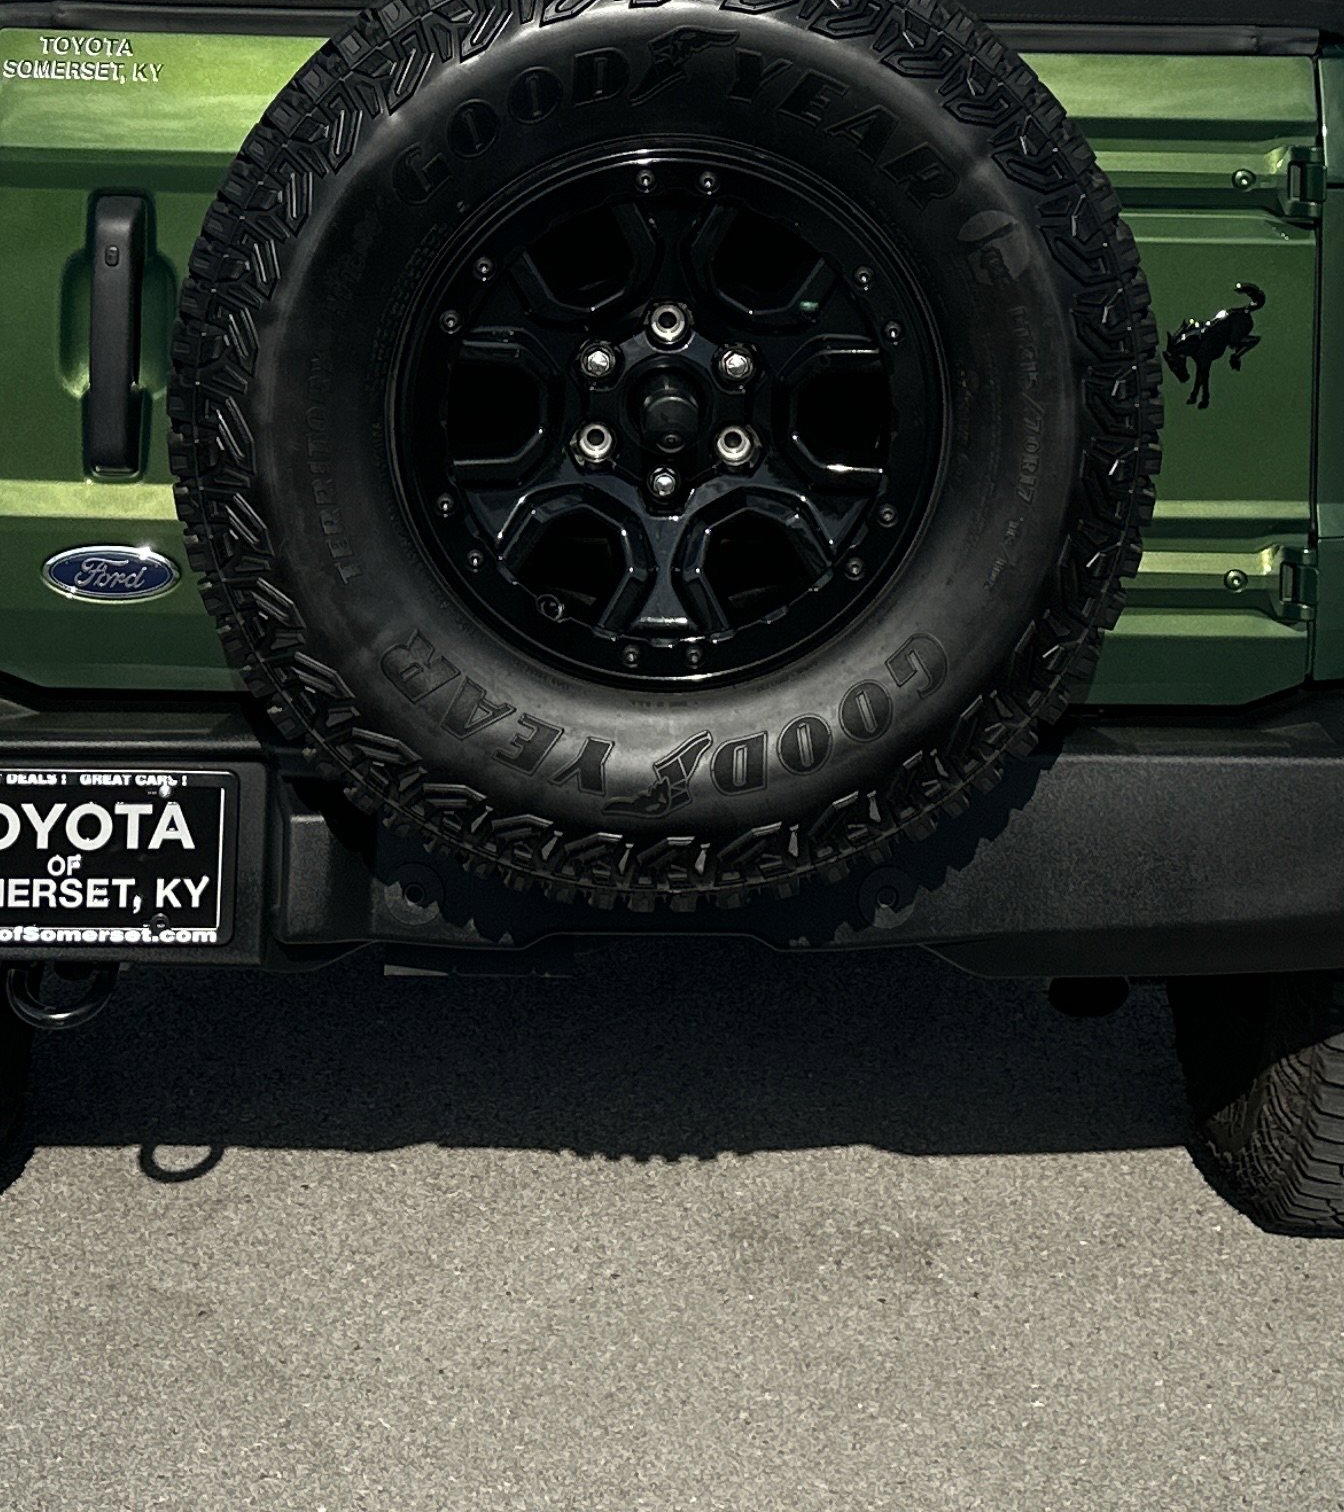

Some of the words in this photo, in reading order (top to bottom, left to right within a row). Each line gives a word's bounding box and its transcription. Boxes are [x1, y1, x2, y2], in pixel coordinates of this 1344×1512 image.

[39, 36, 134, 57] TOYOTA
[2, 59, 128, 85] SOMERSET,
[132, 63, 165, 83] KY
[73, 557, 148, 589] Ford
[79, 773, 132, 786] GREAT
[47, 853, 83, 877] OF
[156, 875, 210, 909] KY
